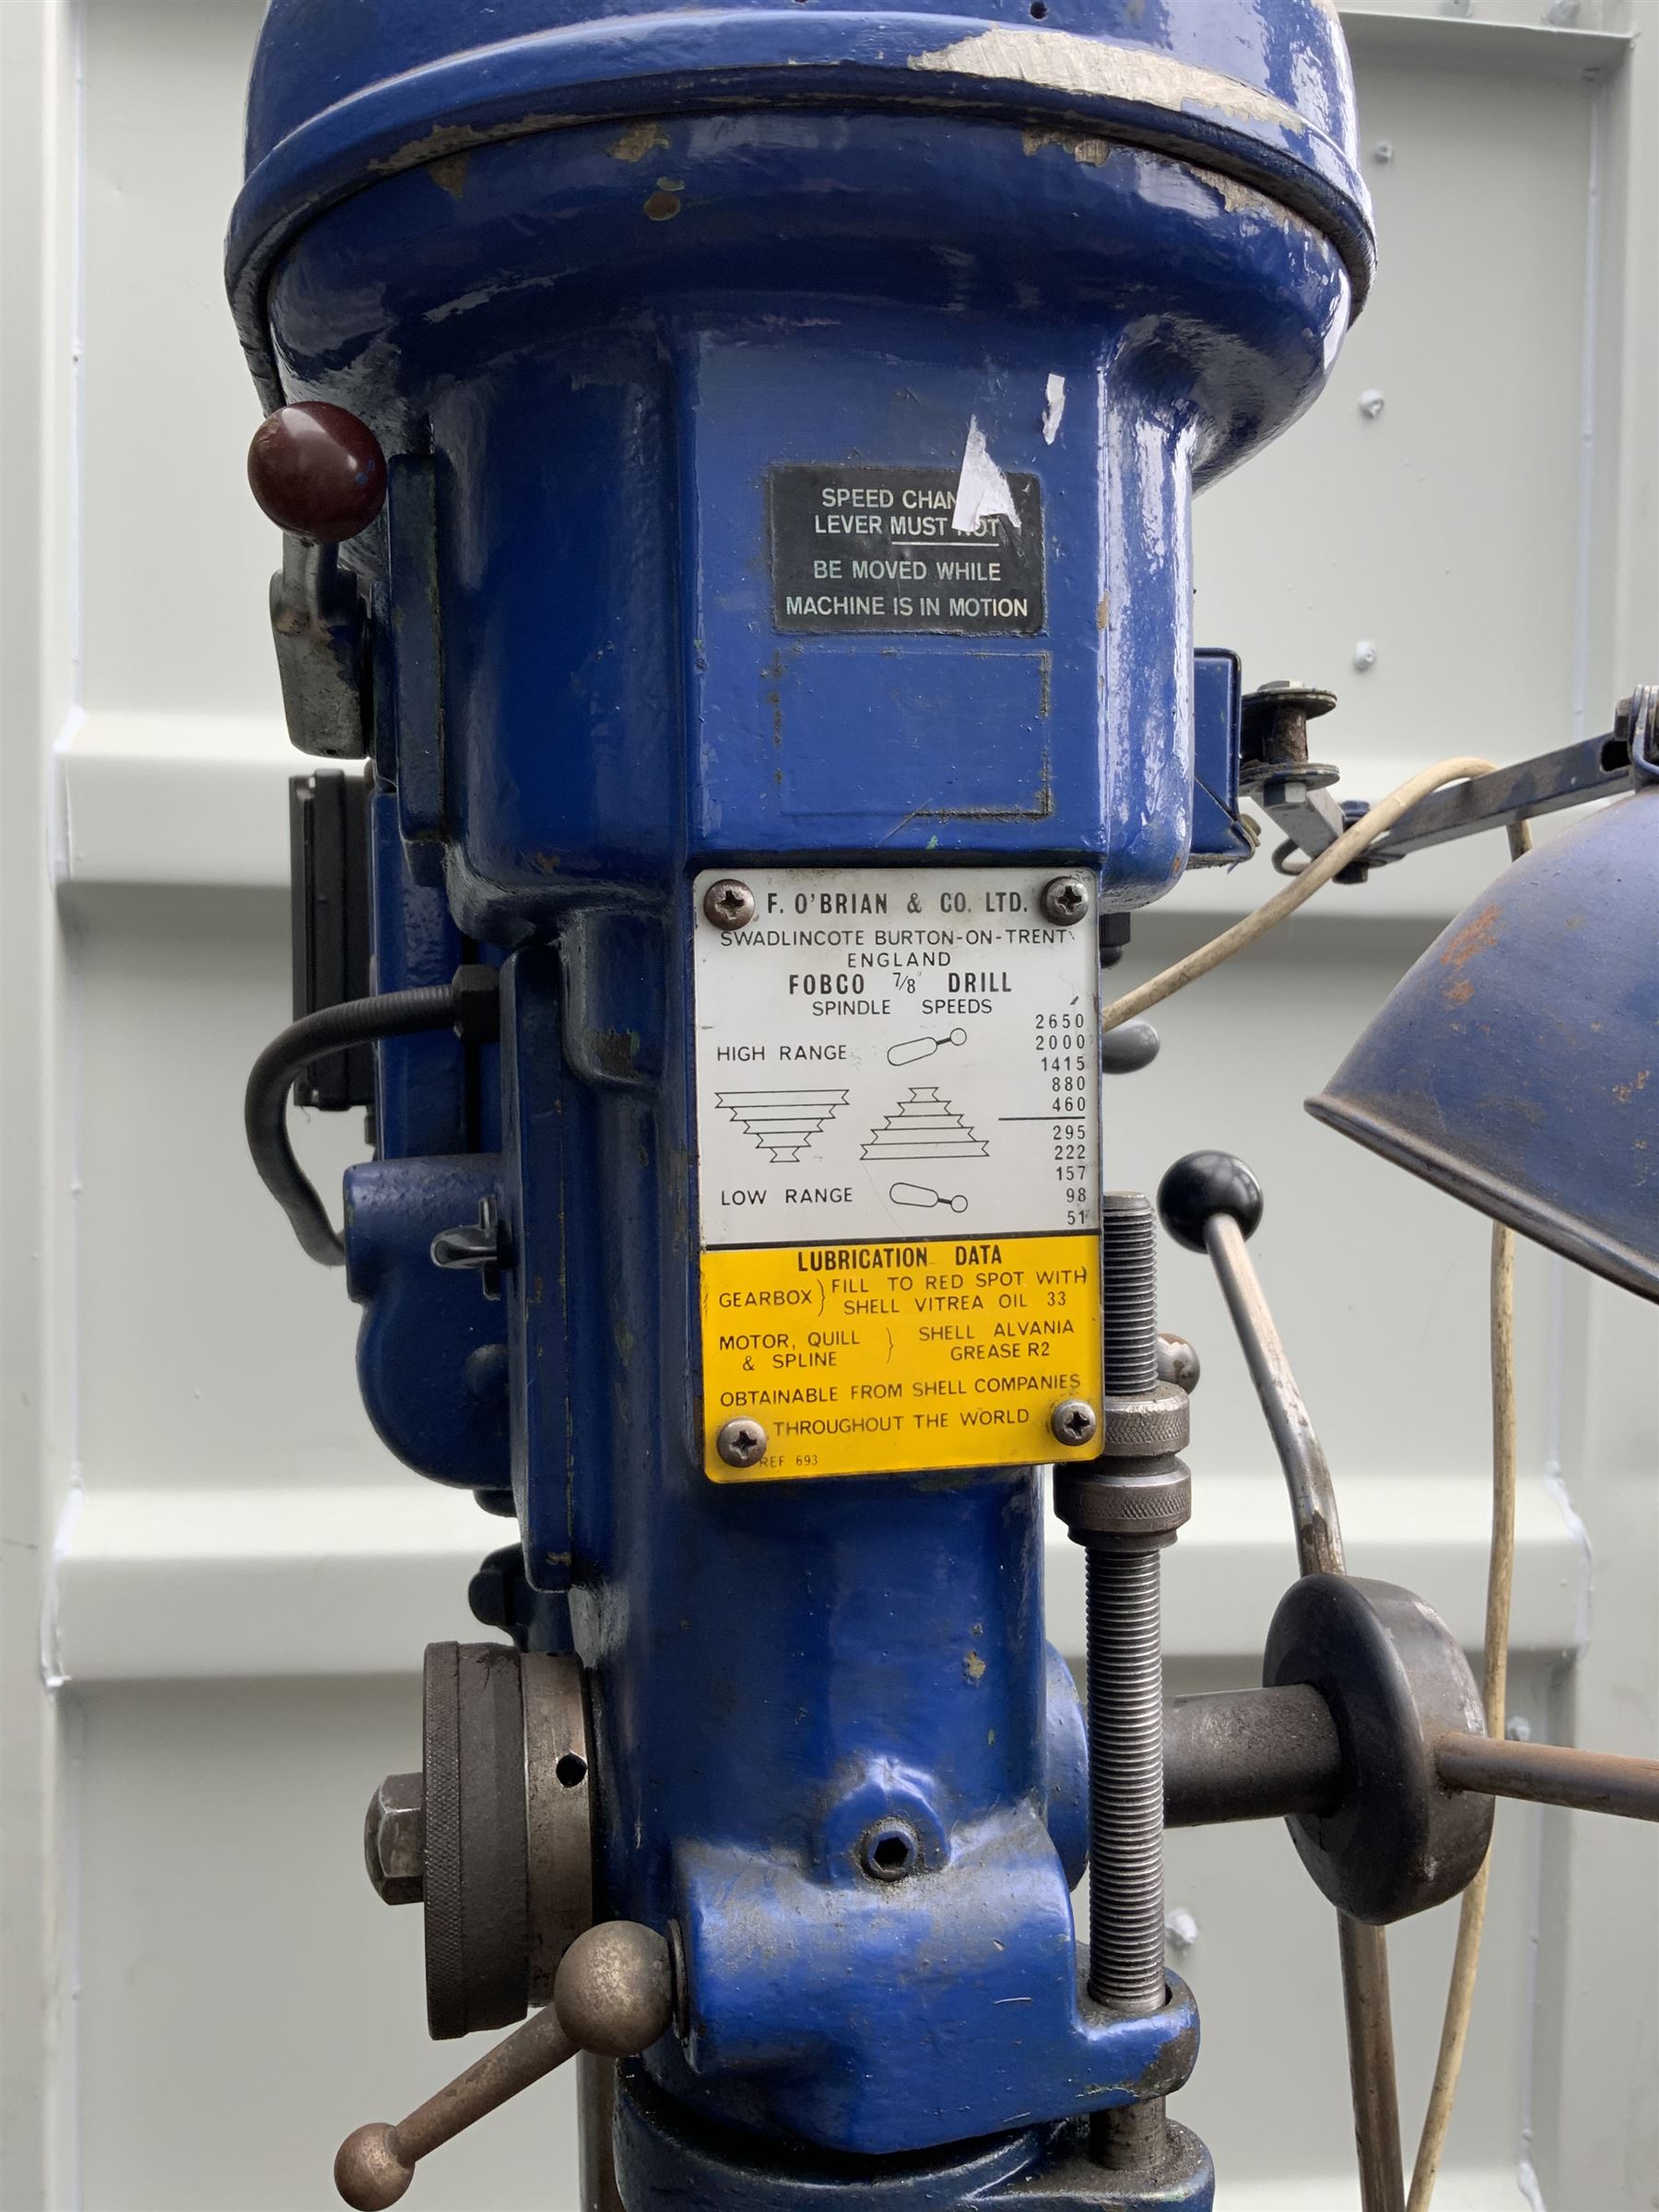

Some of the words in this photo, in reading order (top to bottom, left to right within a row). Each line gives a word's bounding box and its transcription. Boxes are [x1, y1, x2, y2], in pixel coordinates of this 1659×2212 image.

[822, 488, 894, 508] SPEED
[902, 489, 957, 509] CHAN
[815, 514, 883, 535] LEVER
[890, 515, 948, 536] MUST
[957, 516, 998, 537] OT
[813, 559, 842, 579] BE
[852, 559, 927, 581] MOVED
[935, 561, 1001, 582] WHILE
[786, 595, 886, 616] MACHINE
[893, 596, 913, 617] IS
[920, 597, 940, 617] IN
[949, 597, 1028, 618] MOTION
[767, 892, 783, 914] F.
[794, 892, 888, 914] O'BRIAN
[906, 892, 923, 914] &
[940, 891, 971, 913] CO.
[985, 891, 1028, 912] LTD.
[720, 929, 865, 947] SWADLINCOTE
[847, 951, 951, 969] ENGLAND
[789, 973, 865, 995] FOBCO
[948, 971, 1012, 994] DRILL
[812, 999, 891, 1017] SPINDLE
[922, 998, 993, 1015] SPEEDS
[1035, 1013, 1084, 1030] 2650
[1035, 1033, 1086, 1051] 2000
[717, 1046, 765, 1062] HIGH
[780, 1044, 847, 1061] RANGE
[1041, 1055, 1086, 1072] 1415
[1052, 1076, 1086, 1092] 880
[1052, 1096, 1086, 1112] 460
[1053, 1124, 1086, 1141] 295
[1054, 1144, 1086, 1160] 222
[1056, 1165, 1086, 1181] 157
[721, 1190, 767, 1206] LOW
[785, 1187, 853, 1204] RANGE
[1065, 1187, 1087, 1203] 98
[1067, 1211, 1086, 1225] 51
[797, 1247, 927, 1272] LUBRICATION
[955, 1244, 1003, 1266] DATA
[831, 1277, 869, 1294] FILL
[887, 1276, 913, 1291] TO
[925, 1274, 964, 1290] RED
[975, 1271, 1025, 1288] SPOT
[1036, 1268, 1086, 1285] WITH
[719, 1289, 812, 1308] GEARBOX
[843, 1299, 900, 1315] SHELL
[914, 1295, 984, 1312] VITREA
[998, 1293, 1028, 1309] OIL
[1047, 1290, 1066, 1307] 33
[719, 1333, 795, 1350] MOTOR,
[807, 1330, 860, 1348] QUILL
[919, 1324, 975, 1342] SHELL
[994, 1319, 1075, 1337] ALVANIA
[950, 1343, 1021, 1361] GREASE
[1028, 1341, 1050, 1357] R2
[742, 1355, 756, 1371] &
[772, 1351, 837, 1369] SPLINE
[720, 1386, 838, 1407] OBTAINABLE
[851, 1382, 902, 1400] FROM
[912, 1380, 967, 1397] SHELL
[974, 1373, 1081, 1394] COMPANIES
[772, 1416, 904, 1436] THROUGHOUT
[912, 1412, 948, 1429] THE
[959, 1408, 1030, 1426] WORLD
[759, 1455, 785, 1467] REF
[795, 1454, 818, 1466] 693
